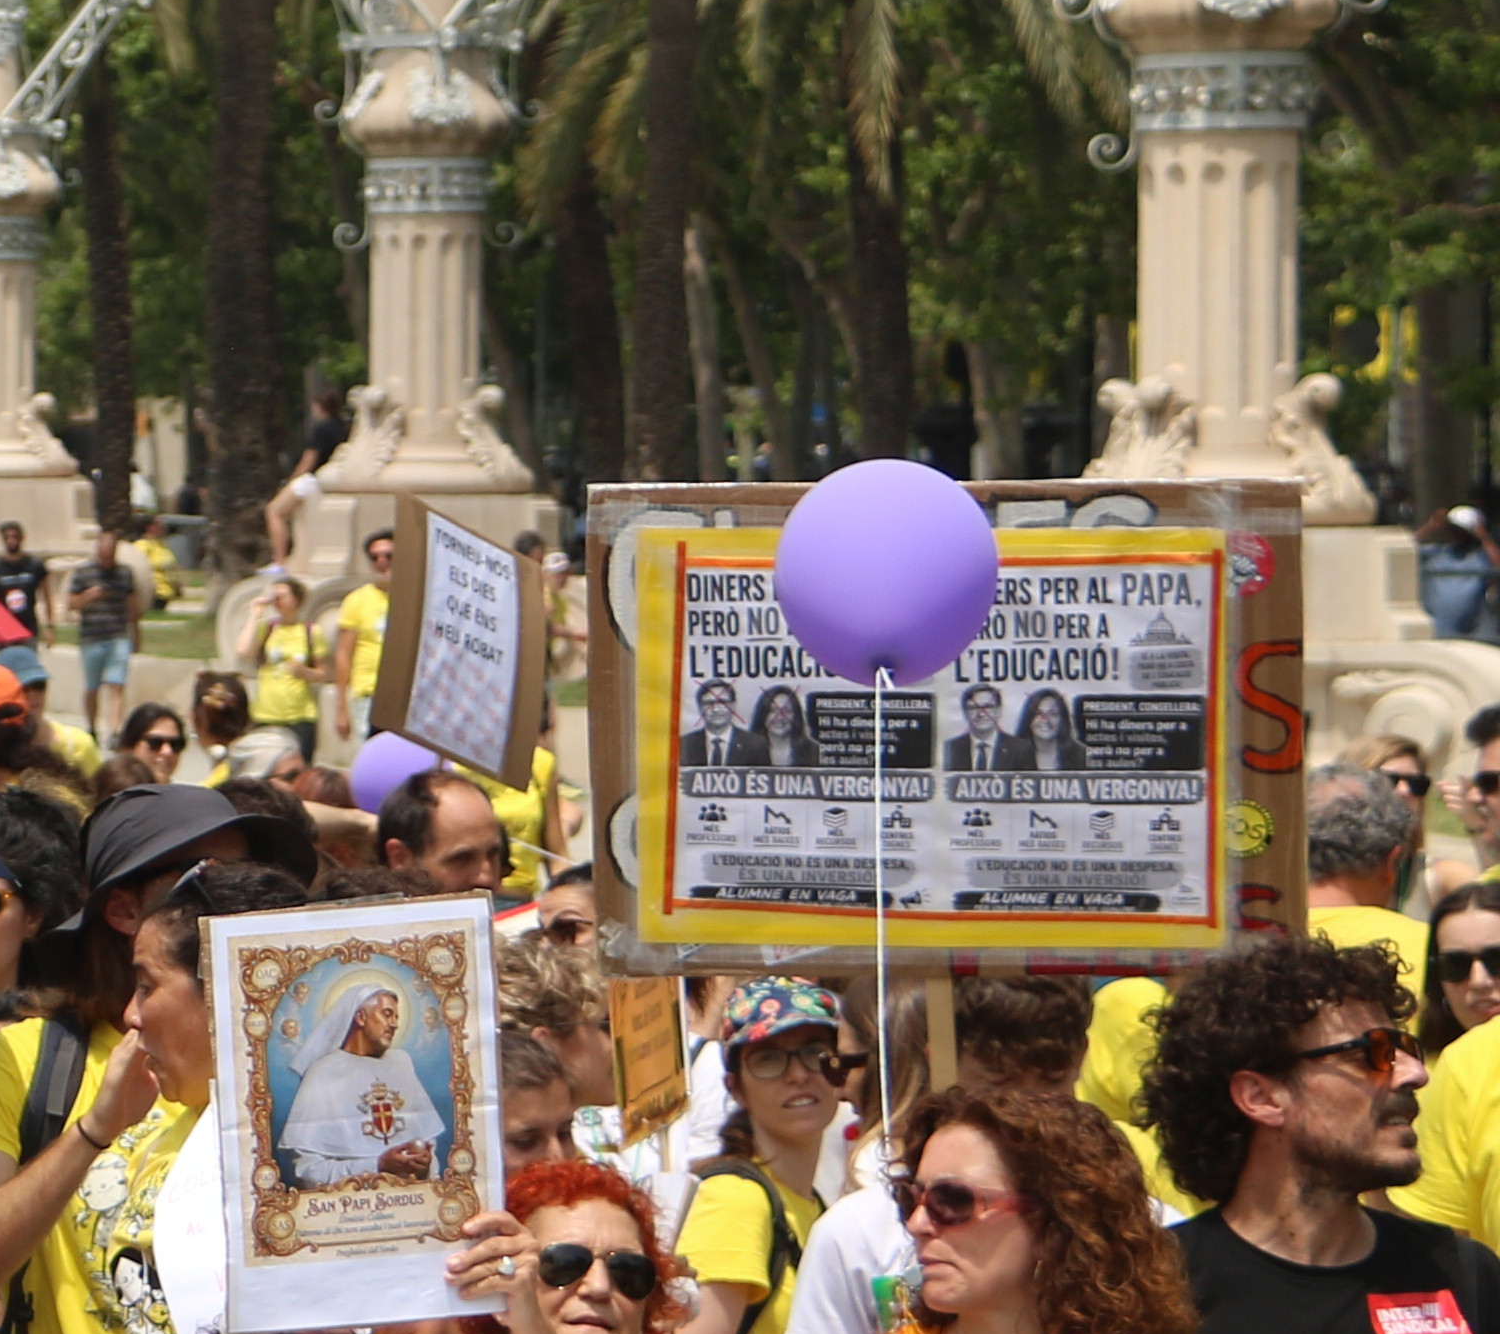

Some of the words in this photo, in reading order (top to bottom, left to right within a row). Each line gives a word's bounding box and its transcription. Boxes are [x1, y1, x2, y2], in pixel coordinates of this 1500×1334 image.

[686, 572, 765, 603] DINERS
[1039, 577, 1078, 605] PER
[1086, 576, 1113, 605] AL
[446, 594, 471, 621] QUE
[687, 607, 740, 637] PERÒ
[747, 606, 780, 637] NO
[1013, 610, 1048, 640] NO
[1053, 613, 1089, 640] PER
[1096, 613, 1110, 640] A
[691, 770, 740, 796] AIXÒ
[745, 769, 770, 796] ÉS
[774, 776, 815, 797] UNA
[955, 774, 1007, 799] AIXÒ
[1010, 774, 1037, 799] ÉS
[1040, 778, 1082, 800] UNA
[1086, 777, 1200, 802] VERGONYA!
[715, 886, 782, 901] ALUMNE
[788, 887, 811, 901] EN
[816, 888, 858, 903] VAGA
[979, 891, 1049, 906] ALUMNE
[1054, 892, 1077, 906] EN
[1081, 892, 1125, 907] VAGA
[303, 1198, 336, 1219] SAN
[371, 1192, 425, 1214] SORDUS
